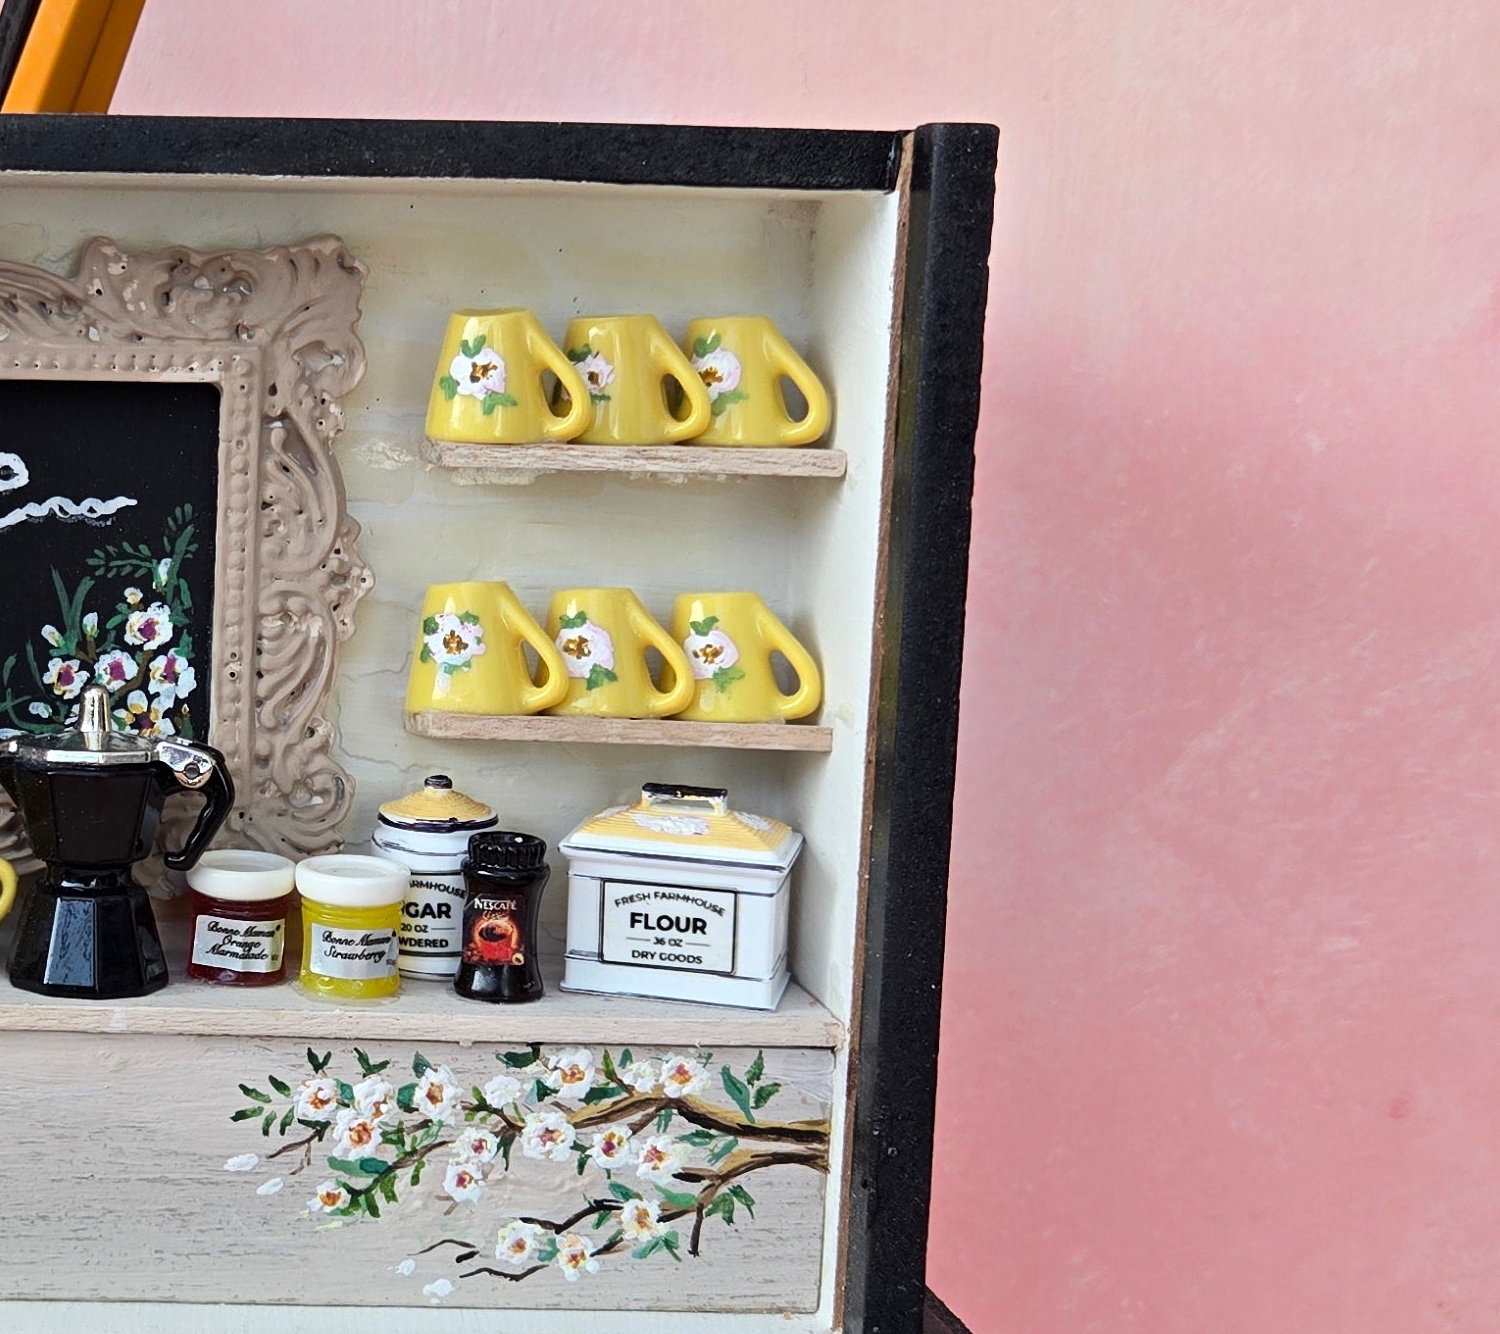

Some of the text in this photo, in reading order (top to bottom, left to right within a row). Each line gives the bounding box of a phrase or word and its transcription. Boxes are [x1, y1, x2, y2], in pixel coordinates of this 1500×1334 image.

[401, 902, 452, 919] GAR
[614, 891, 726, 917] FRESH FARMHOUSE
[400, 923, 428, 933] 20 OZ
[629, 912, 707, 935] FLOUR
[668, 938, 683, 947] OZ
[631, 949, 703, 965] DRY GOODS
